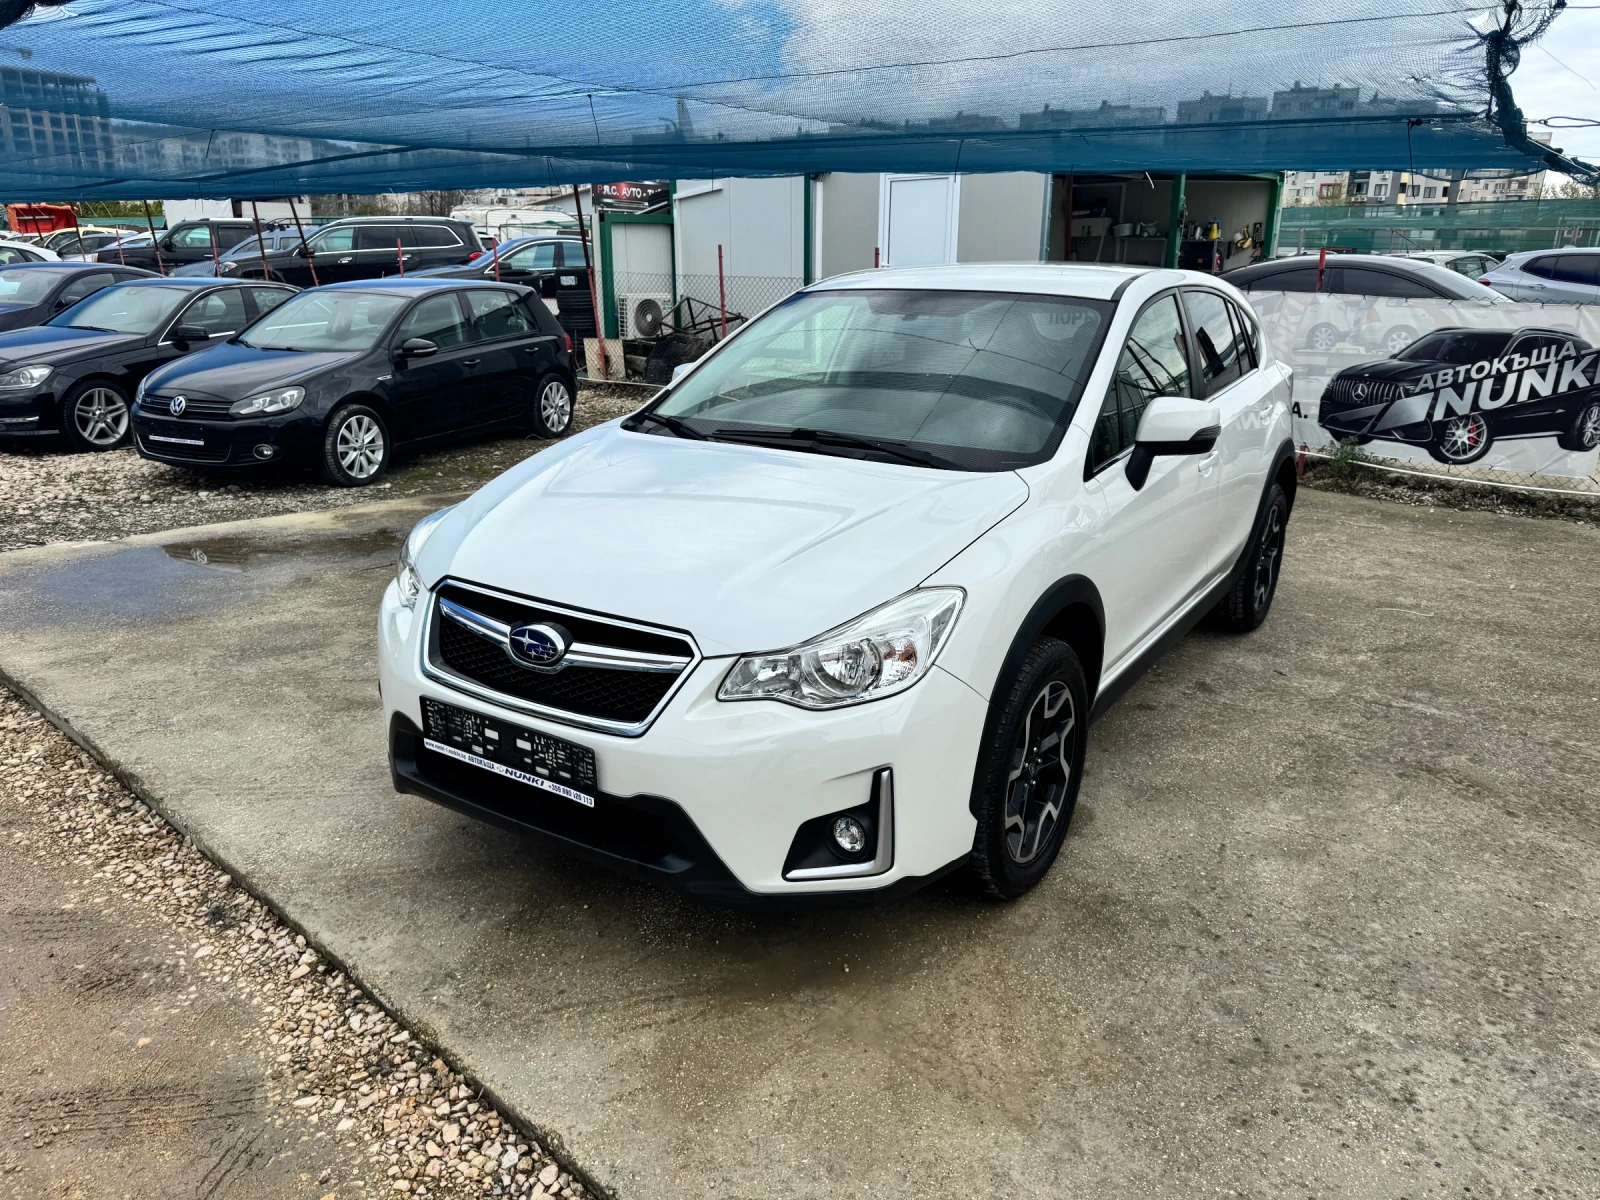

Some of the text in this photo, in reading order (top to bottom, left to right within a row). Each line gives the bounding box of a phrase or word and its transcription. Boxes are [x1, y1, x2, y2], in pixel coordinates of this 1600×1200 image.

[1414, 341, 1577, 394] АВТОКЪЩА
[1432, 353, 1600, 422] NUNK
[467, 755, 496, 770] АВТОКЪЩА
[504, 768, 545, 787] NUNKI
[583, 795, 593, 805] 113
